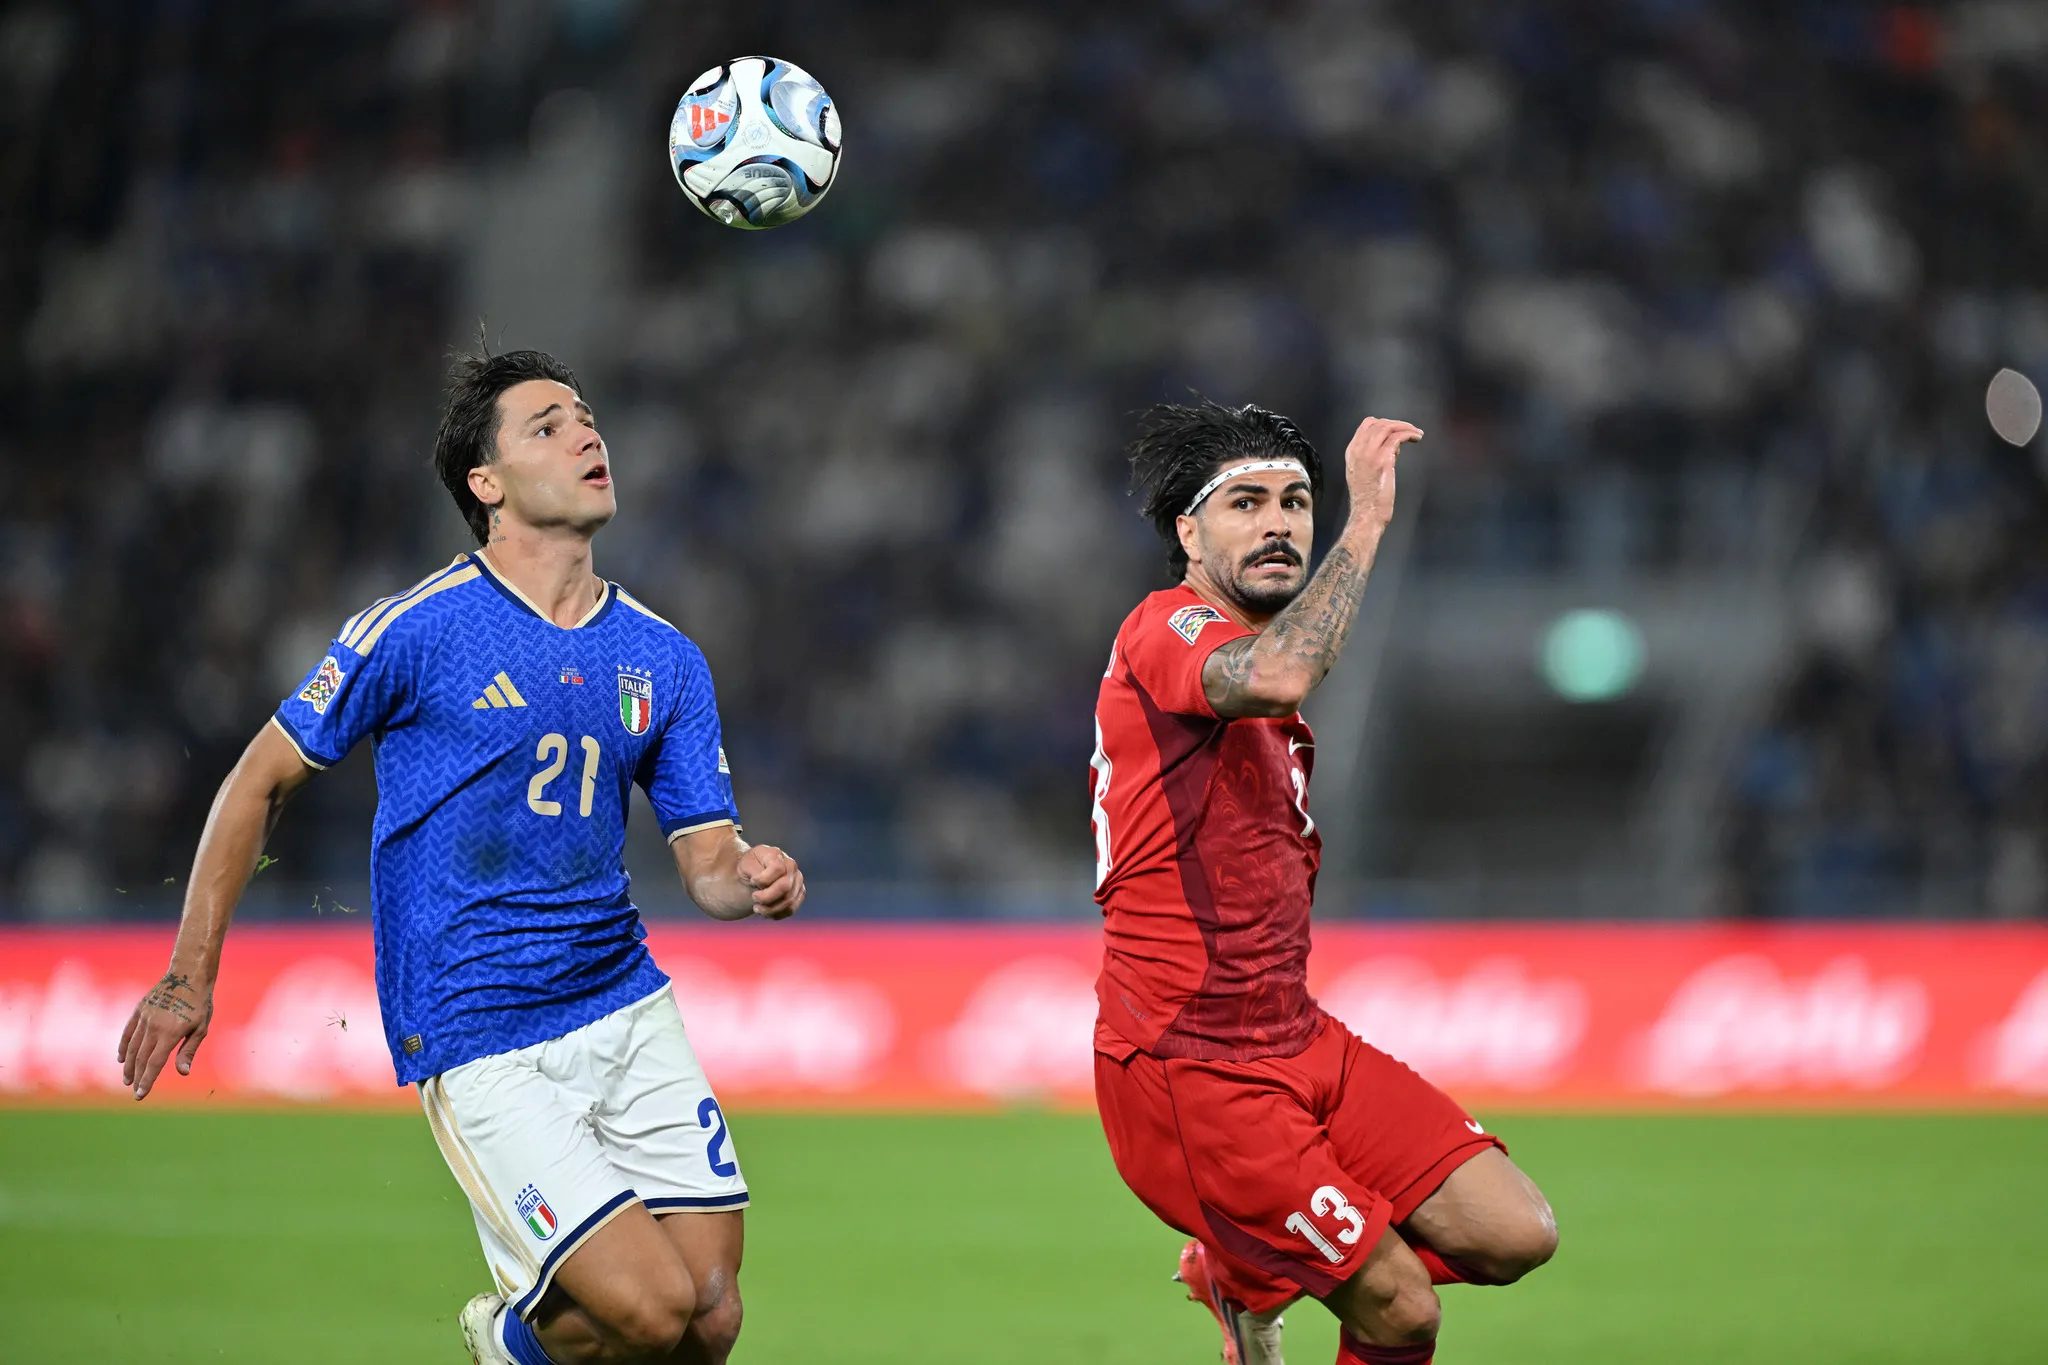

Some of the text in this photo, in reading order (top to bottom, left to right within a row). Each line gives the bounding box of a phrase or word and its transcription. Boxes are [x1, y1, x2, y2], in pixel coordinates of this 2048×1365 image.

[620, 677, 649, 694] ITALIA
[527, 732, 600, 817] 21
[520, 1194, 540, 1217] ITALIA
[1285, 1185, 1366, 1264] 13
